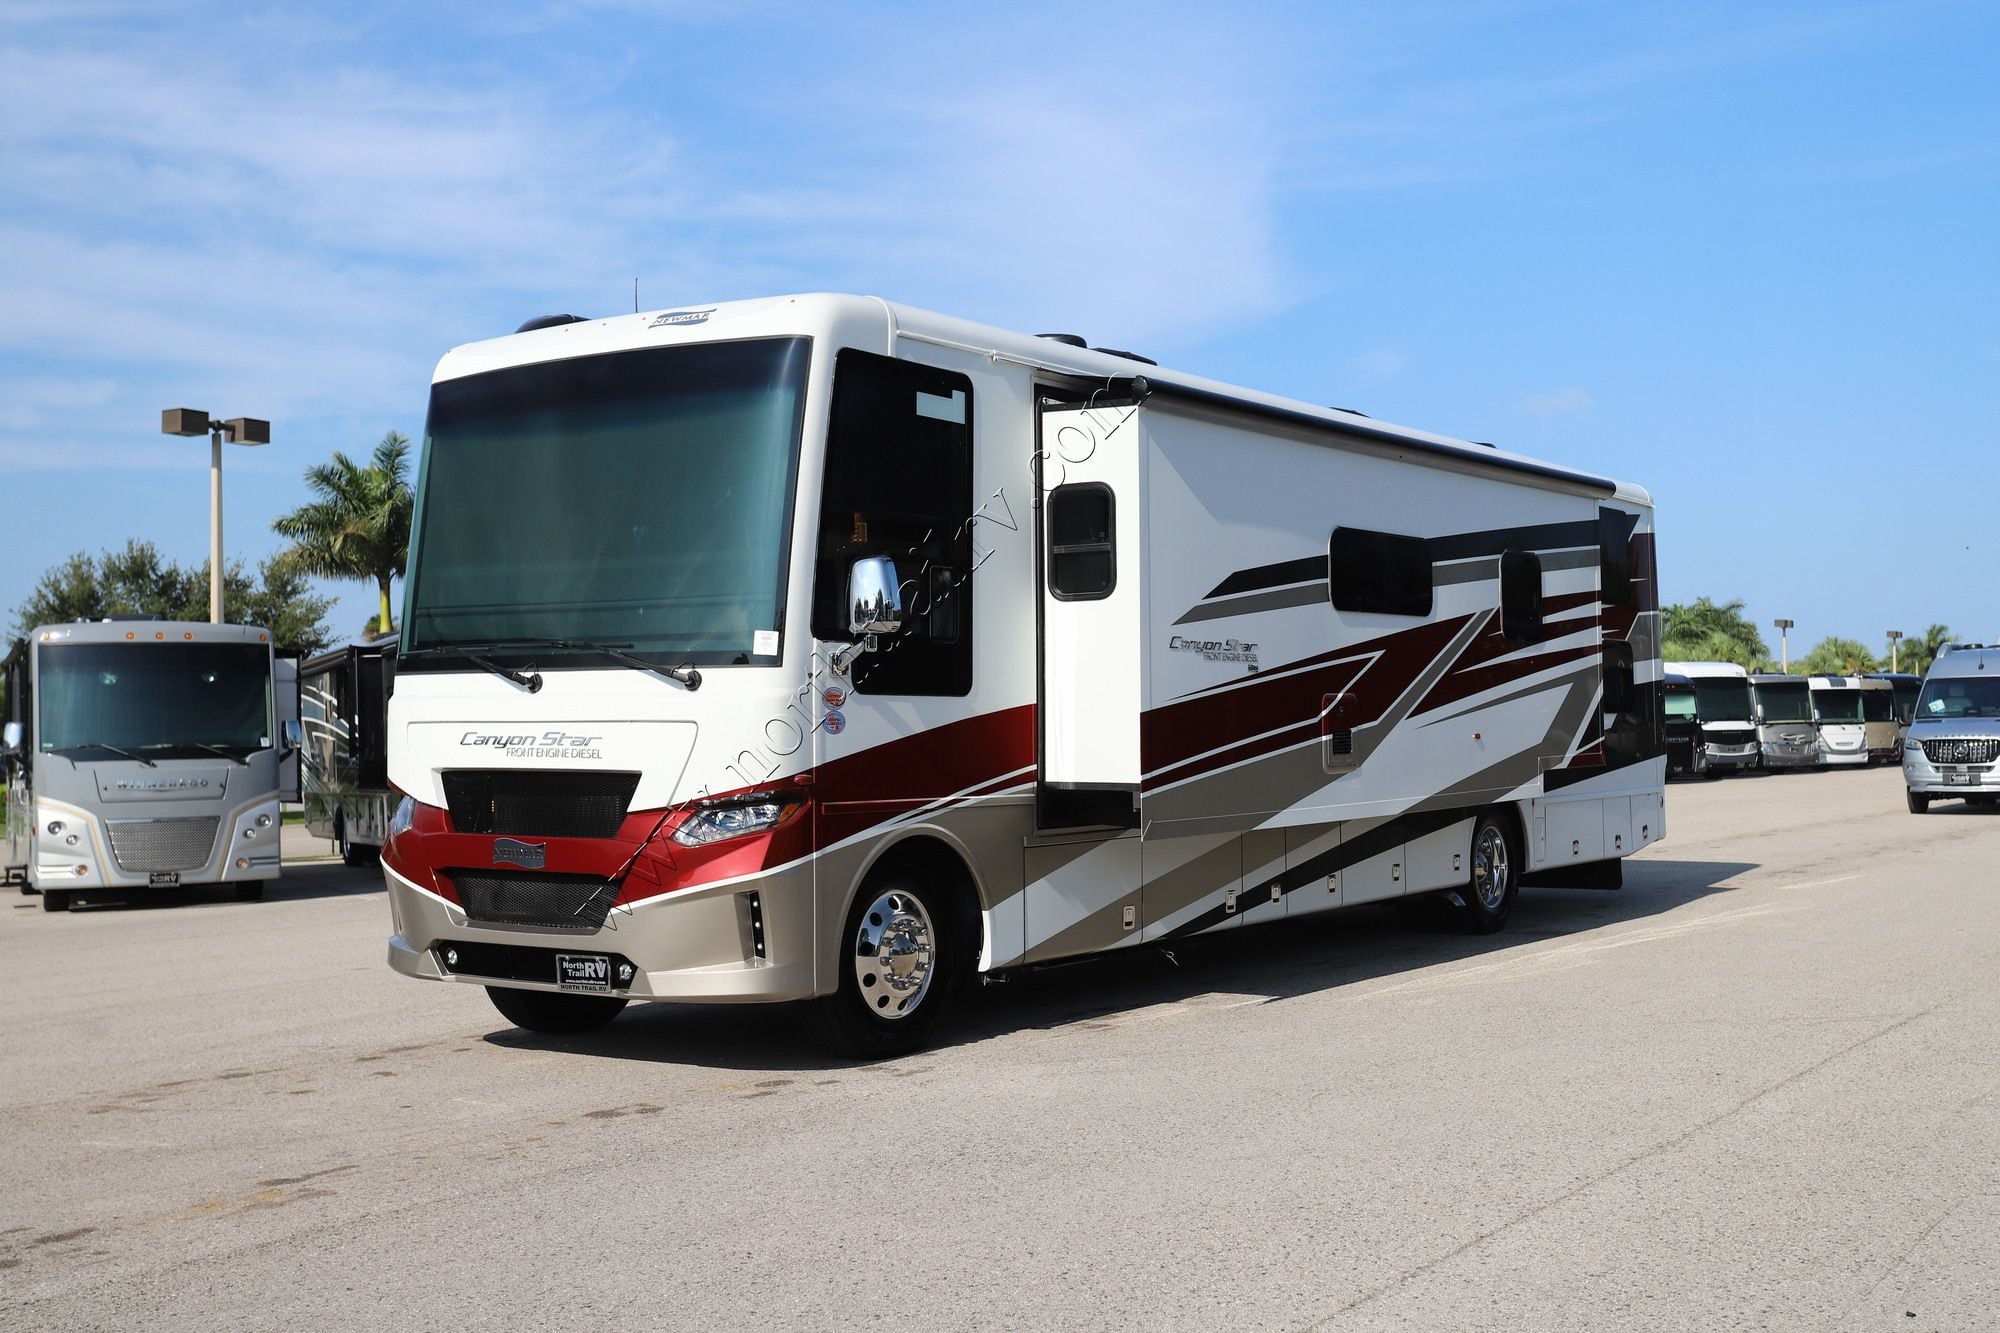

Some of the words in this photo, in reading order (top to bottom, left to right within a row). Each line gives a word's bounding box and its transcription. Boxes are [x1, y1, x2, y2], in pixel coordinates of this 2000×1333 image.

[1169, 636, 1222, 653] Canyon
[459, 731, 537, 749] Canyon
[539, 731, 603, 746] Star
[506, 747, 534, 758] FRONT
[535, 747, 570, 758] ENGINE
[570, 748, 603, 759] DIESEL
[562, 961, 584, 969] North
[584, 961, 606, 978] RV
[567, 969, 584, 977] Trail
